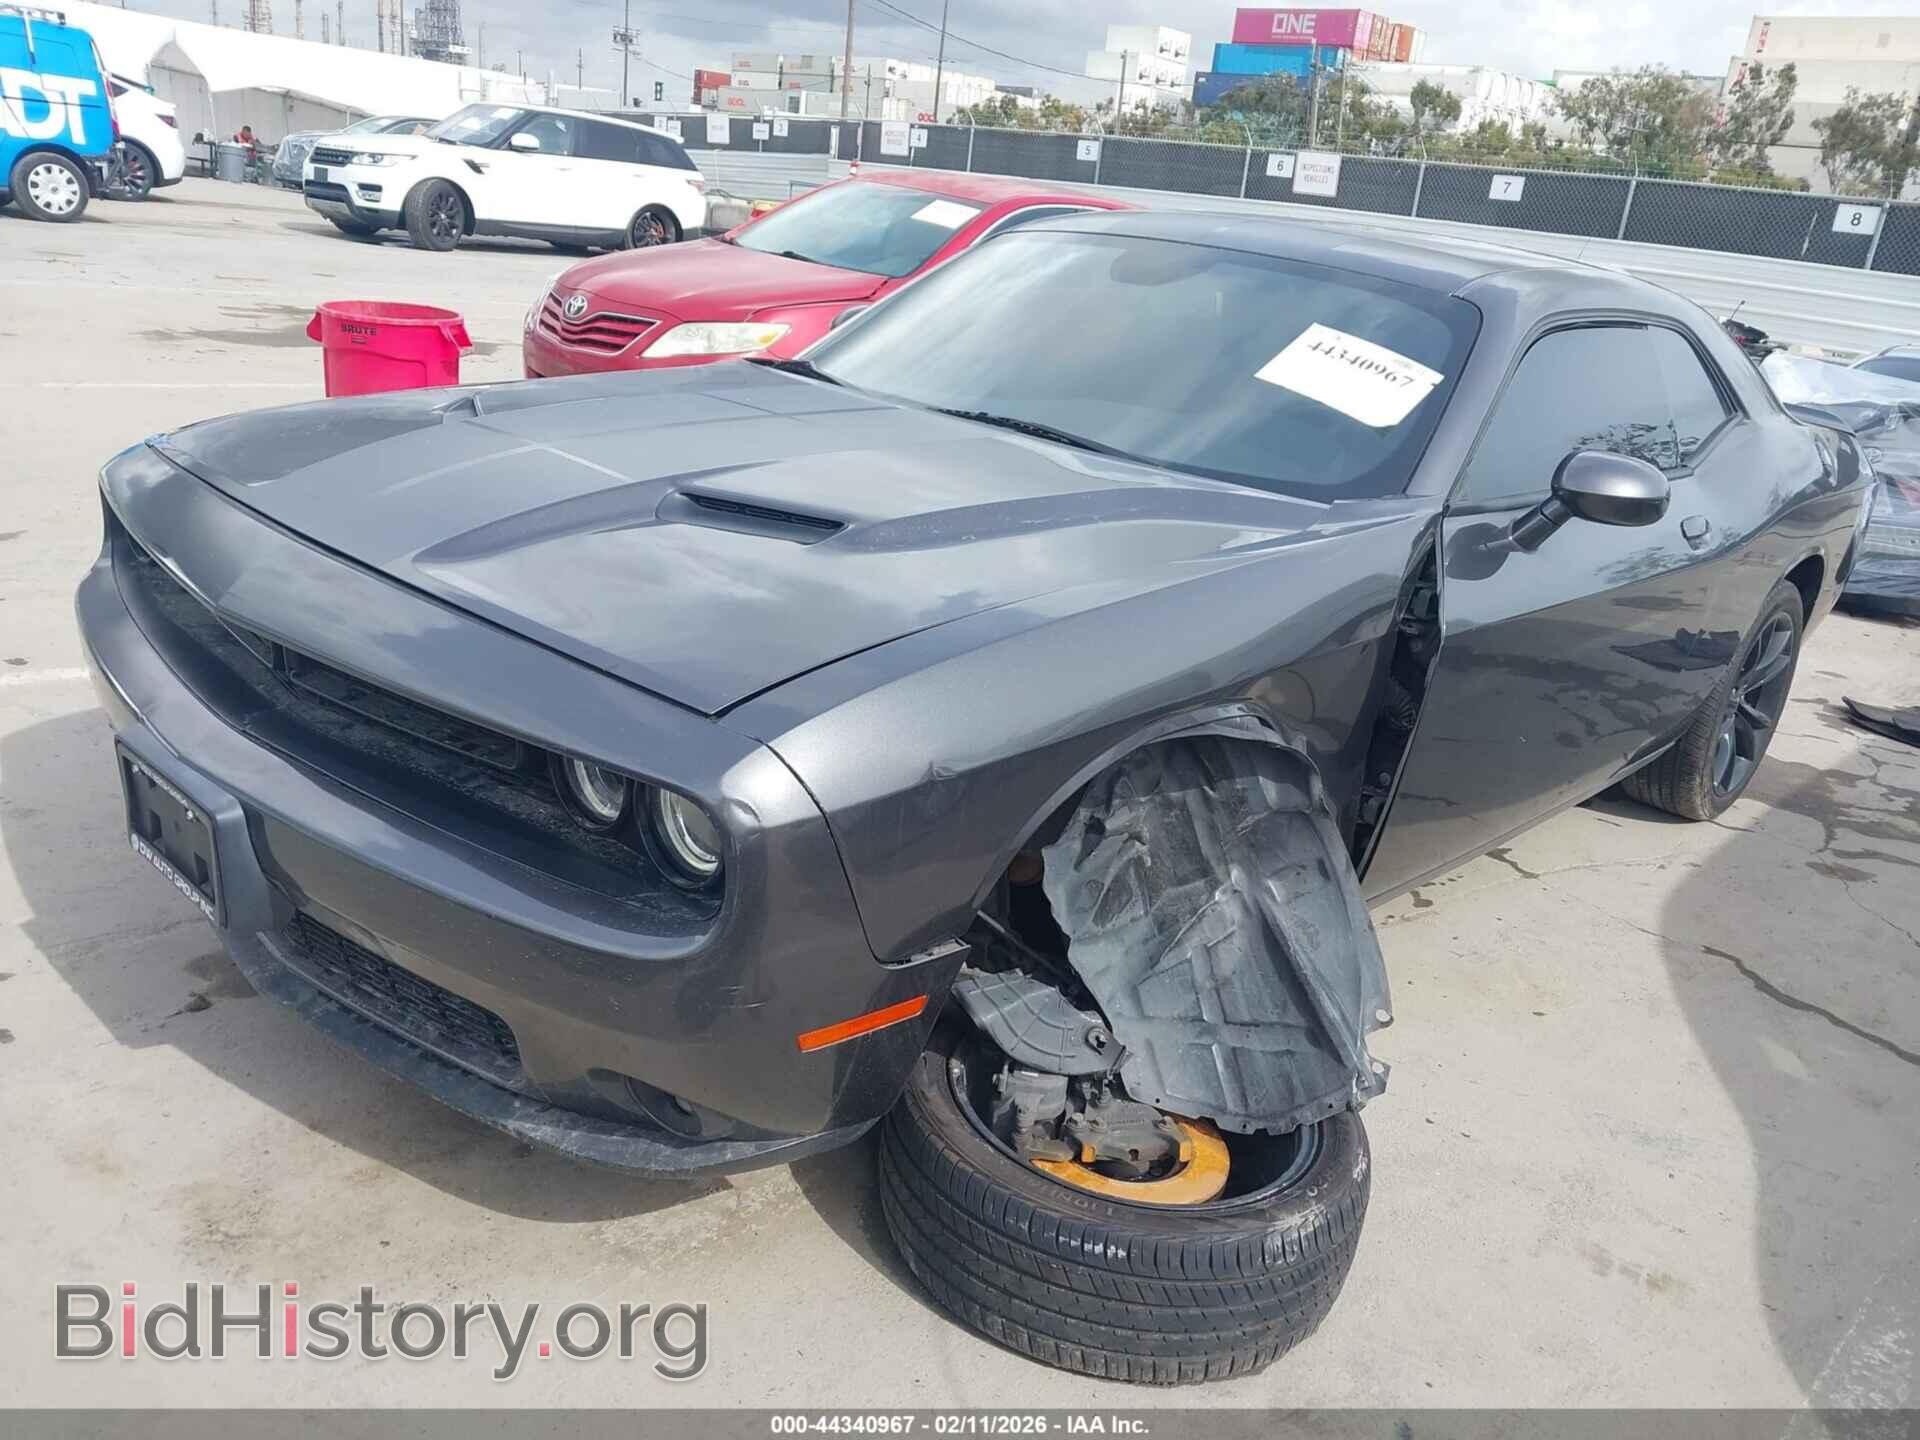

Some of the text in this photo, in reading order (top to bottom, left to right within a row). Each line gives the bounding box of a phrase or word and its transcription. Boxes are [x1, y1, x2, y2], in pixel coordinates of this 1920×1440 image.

[1271, 13, 1317, 33] ONE
[0, 66, 97, 145] DT
[1084, 145, 1092, 156] 5
[1277, 160, 1285, 172] 6
[1503, 181, 1512, 194] 7
[1851, 212, 1862, 226] 8
[341, 322, 377, 336] BRUTE
[1307, 340, 1415, 388] 44340967
